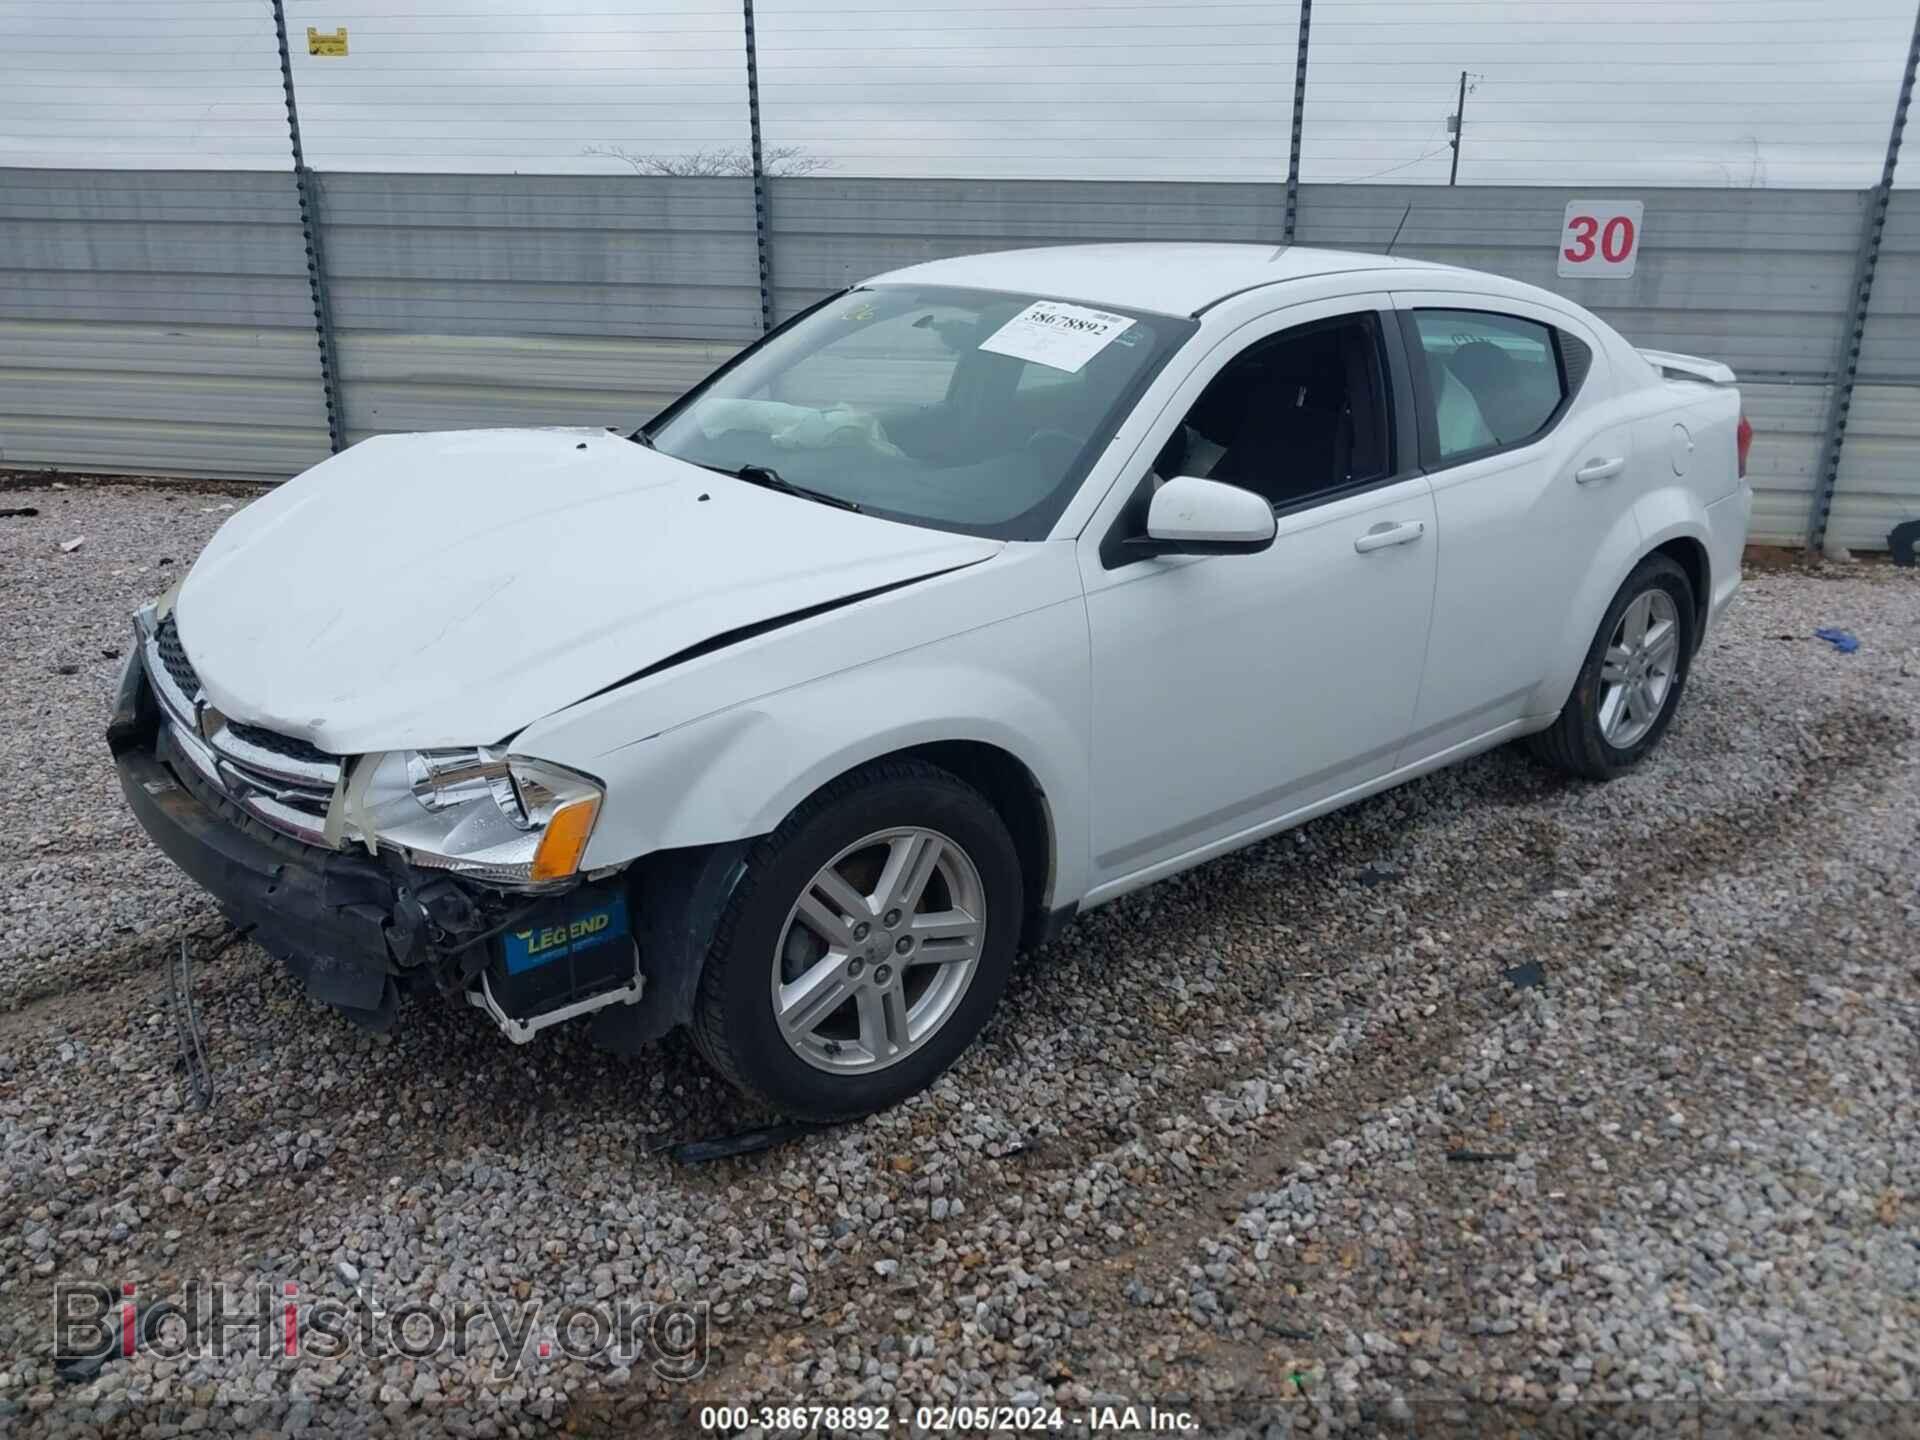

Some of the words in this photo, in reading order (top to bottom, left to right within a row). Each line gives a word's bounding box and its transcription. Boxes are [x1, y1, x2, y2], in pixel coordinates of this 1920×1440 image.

[1564, 216, 1634, 263] 30
[1025, 311, 1108, 336] 38678892
[528, 914, 609, 954] LEGEND
